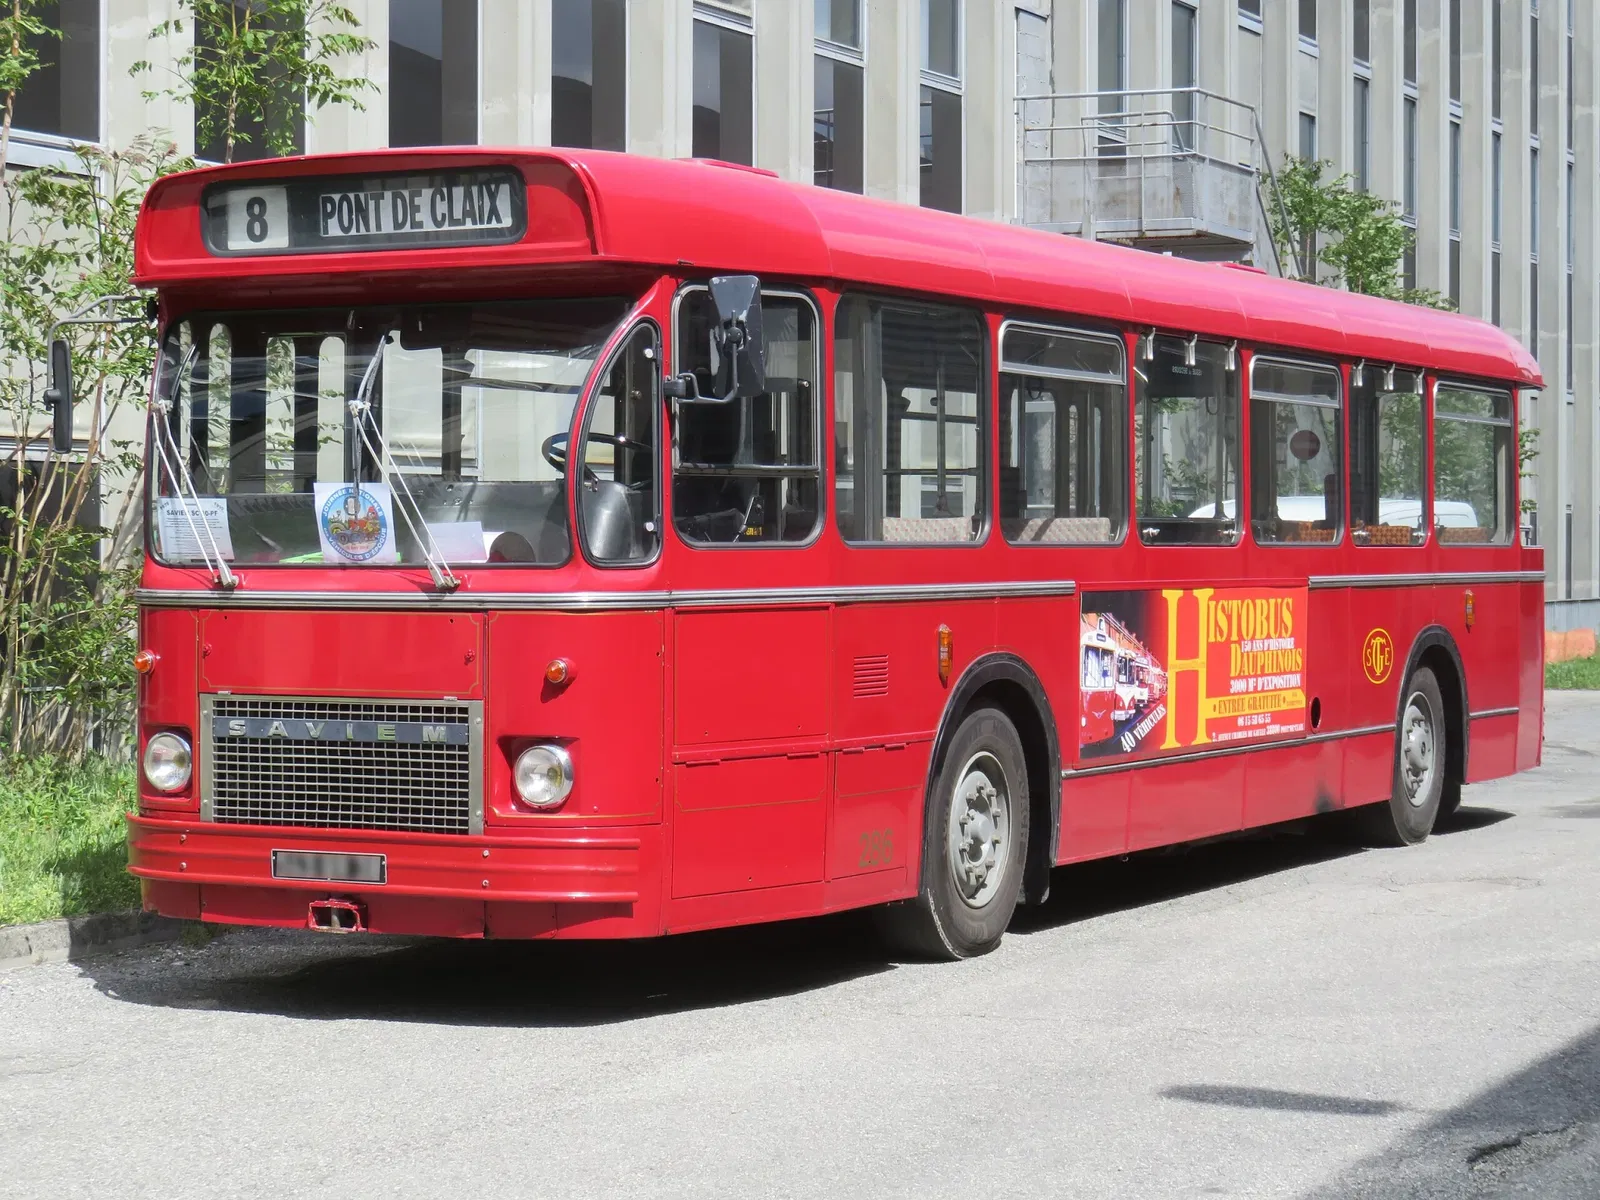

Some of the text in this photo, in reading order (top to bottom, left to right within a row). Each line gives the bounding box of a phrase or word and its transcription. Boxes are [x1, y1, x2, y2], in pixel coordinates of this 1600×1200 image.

[246, 196, 269, 243] 8
[321, 182, 504, 236] PONT DE CLAIX
[348, 488, 384, 517] NTIONALE
[1230, 644, 1302, 676] DAUPHINOIS
[1257, 674, 1300, 691] D'EXPOSITION
[1218, 697, 1245, 714] ENTRÉE
[1248, 694, 1281, 711] GRATUITE
[228, 719, 448, 743] SAVIEM
[1120, 703, 1167, 753] 40 VÉHICULES
[858, 827, 893, 869] 286
